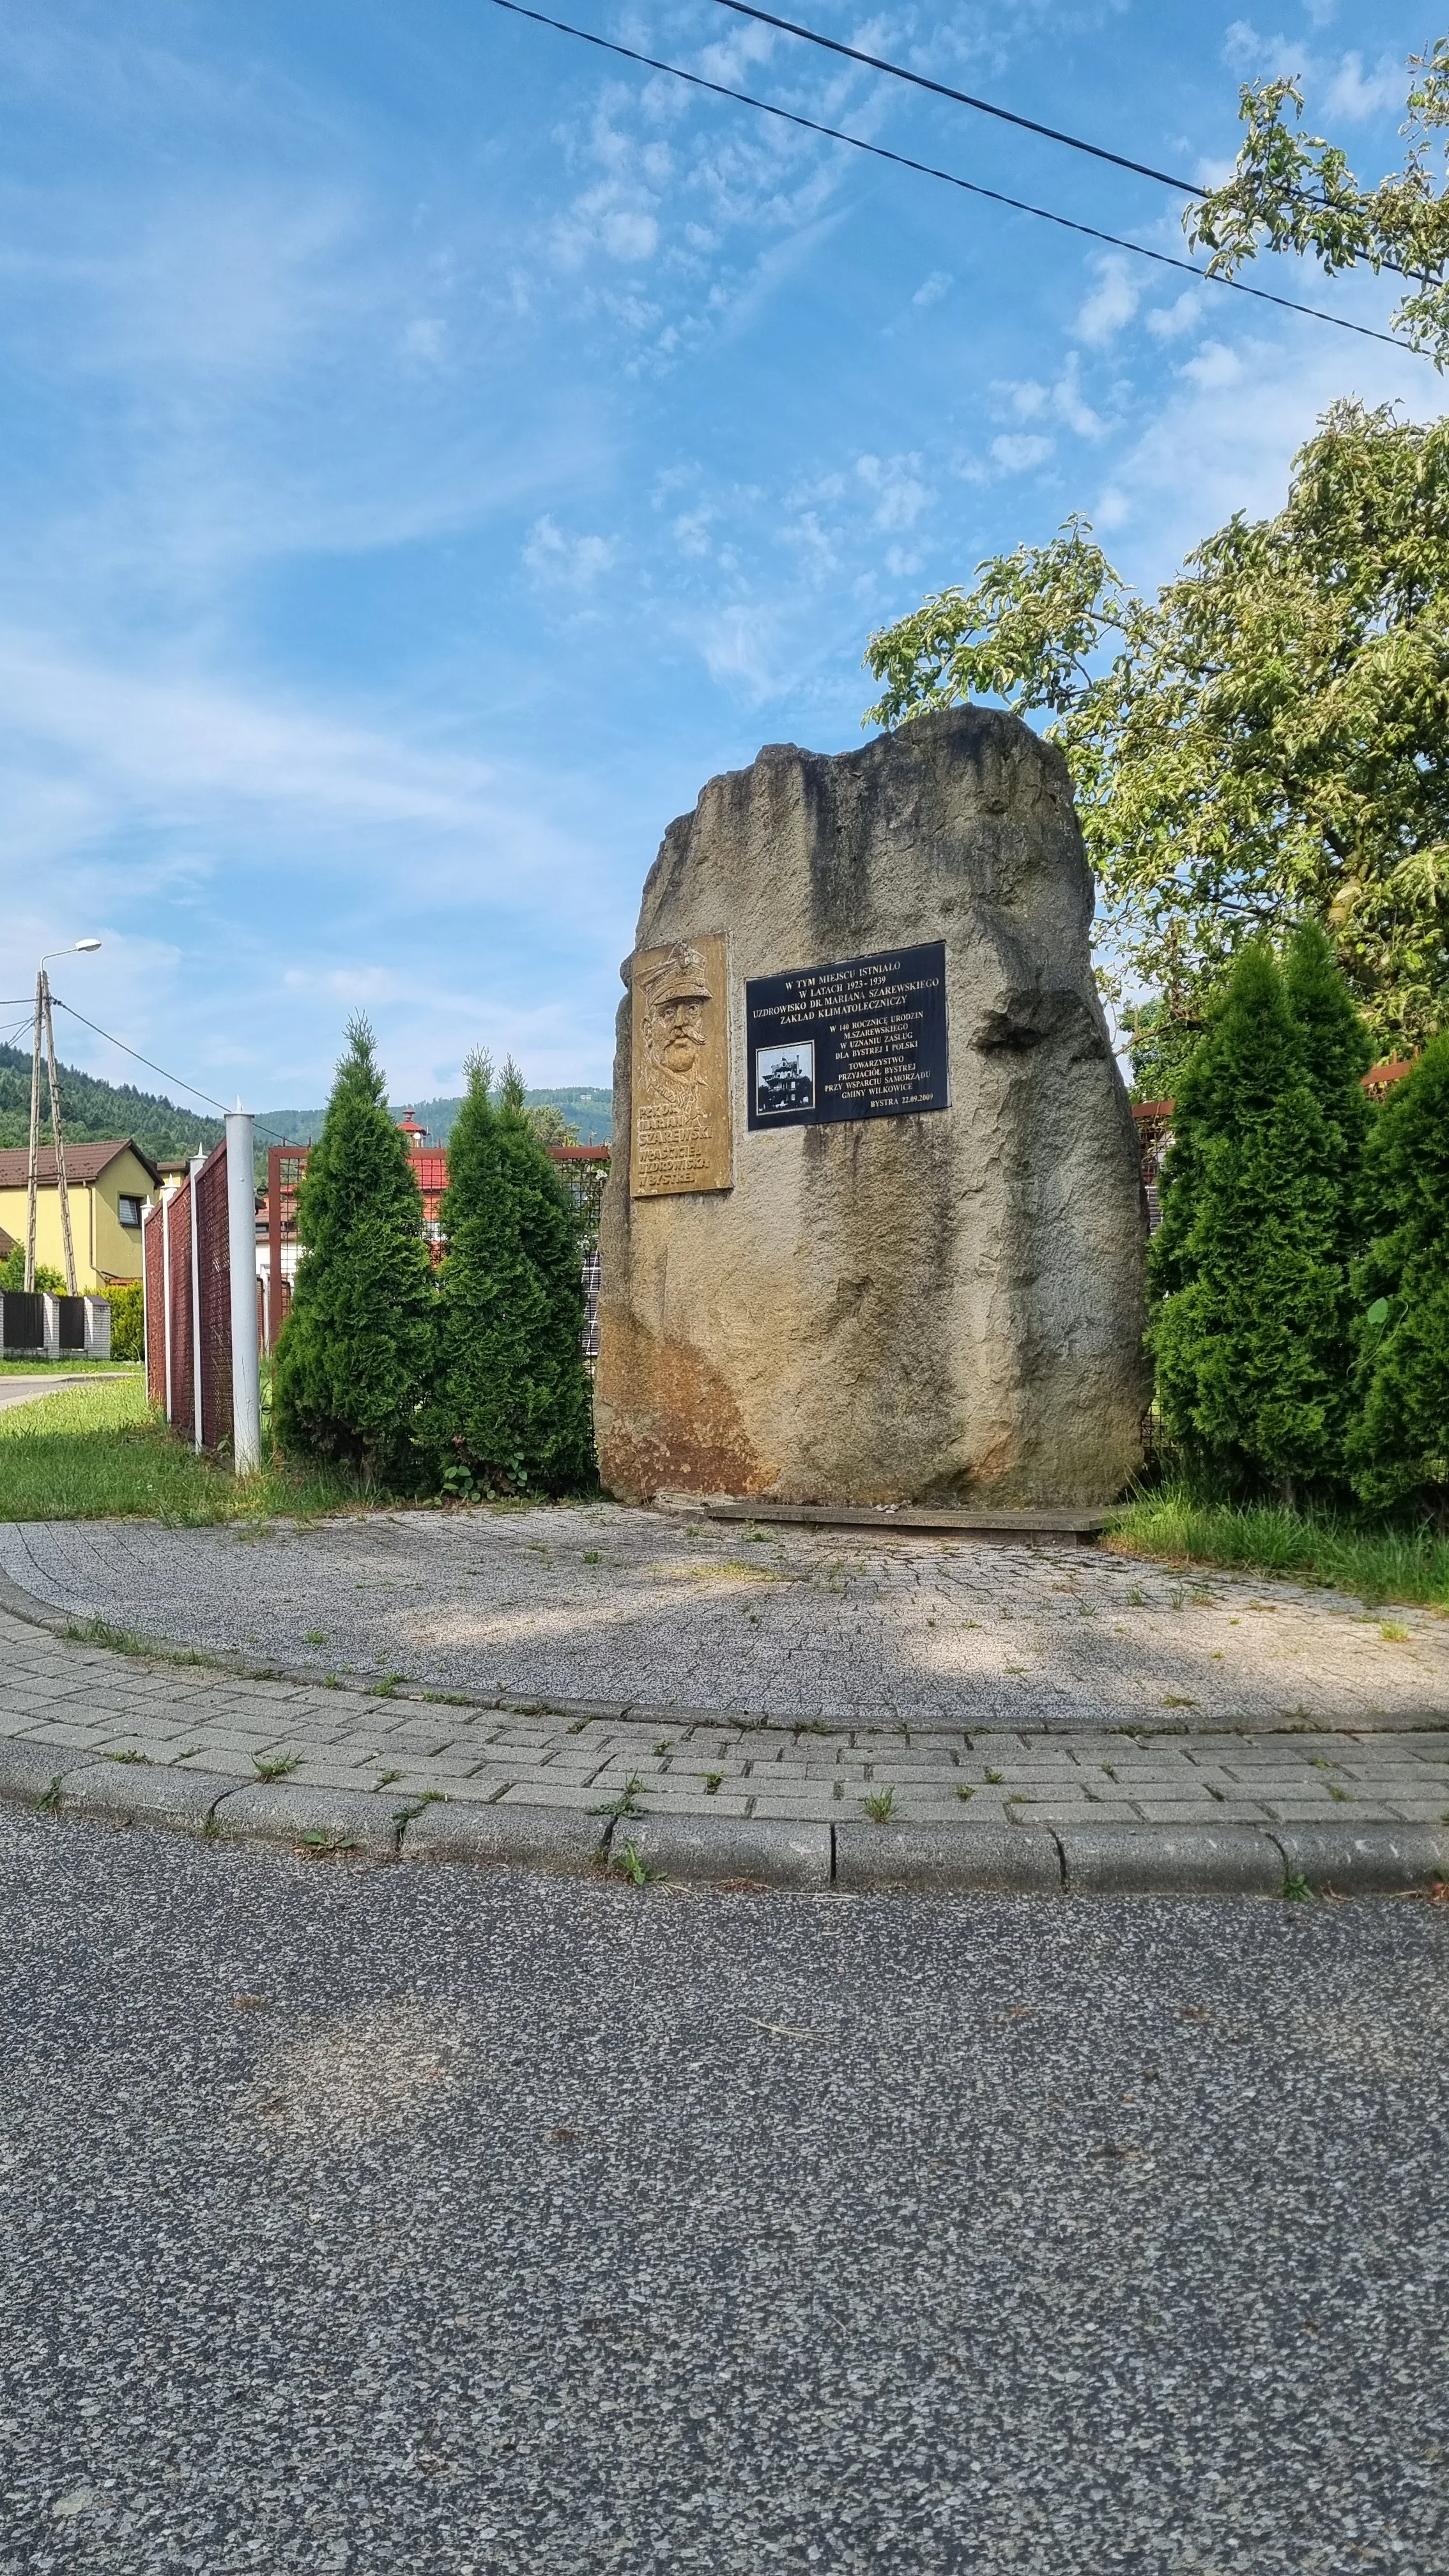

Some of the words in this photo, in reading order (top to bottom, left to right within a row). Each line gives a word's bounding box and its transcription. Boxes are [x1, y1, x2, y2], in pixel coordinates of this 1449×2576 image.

[785, 982, 793, 990] W
[796, 978, 816, 989] TYM
[819, 970, 855, 985] MIEJSCU
[753, 1001, 807, 1018] UZDROWISKO
[824, 992, 865, 1006] MARIANA
[869, 977, 939, 998] SZAREWSKIEGO
[799, 990, 807, 999] W
[811, 983, 843, 997] LATACH
[818, 995, 908, 1018] KLIMATOLECZNICZY
[852, 1017, 888, 1029] ROCZNICĘ
[891, 1011, 923, 1023] URODZIN
[850, 1037, 881, 1048] UZNANIU
[852, 1046, 882, 1057] BYSTREJ
[892, 1040, 918, 1051] POLSKI
[848, 1055, 904, 1070] TOWARZYSTWO
[884, 1063, 916, 1074] BYSTREJ
[825, 1084, 843, 1092] PRZY
[845, 1078, 882, 1089] WSPARCIU
[884, 1071, 931, 1084] SAMORZĄDU
[841, 1089, 866, 1099] GMINY
[868, 1083, 913, 1095] WILKOWICE
[870, 1097, 899, 1108] BYSTRA
[901, 1093, 933, 1104] 22.09.2009
[638, 1125, 712, 1146] SZAREWSKI
